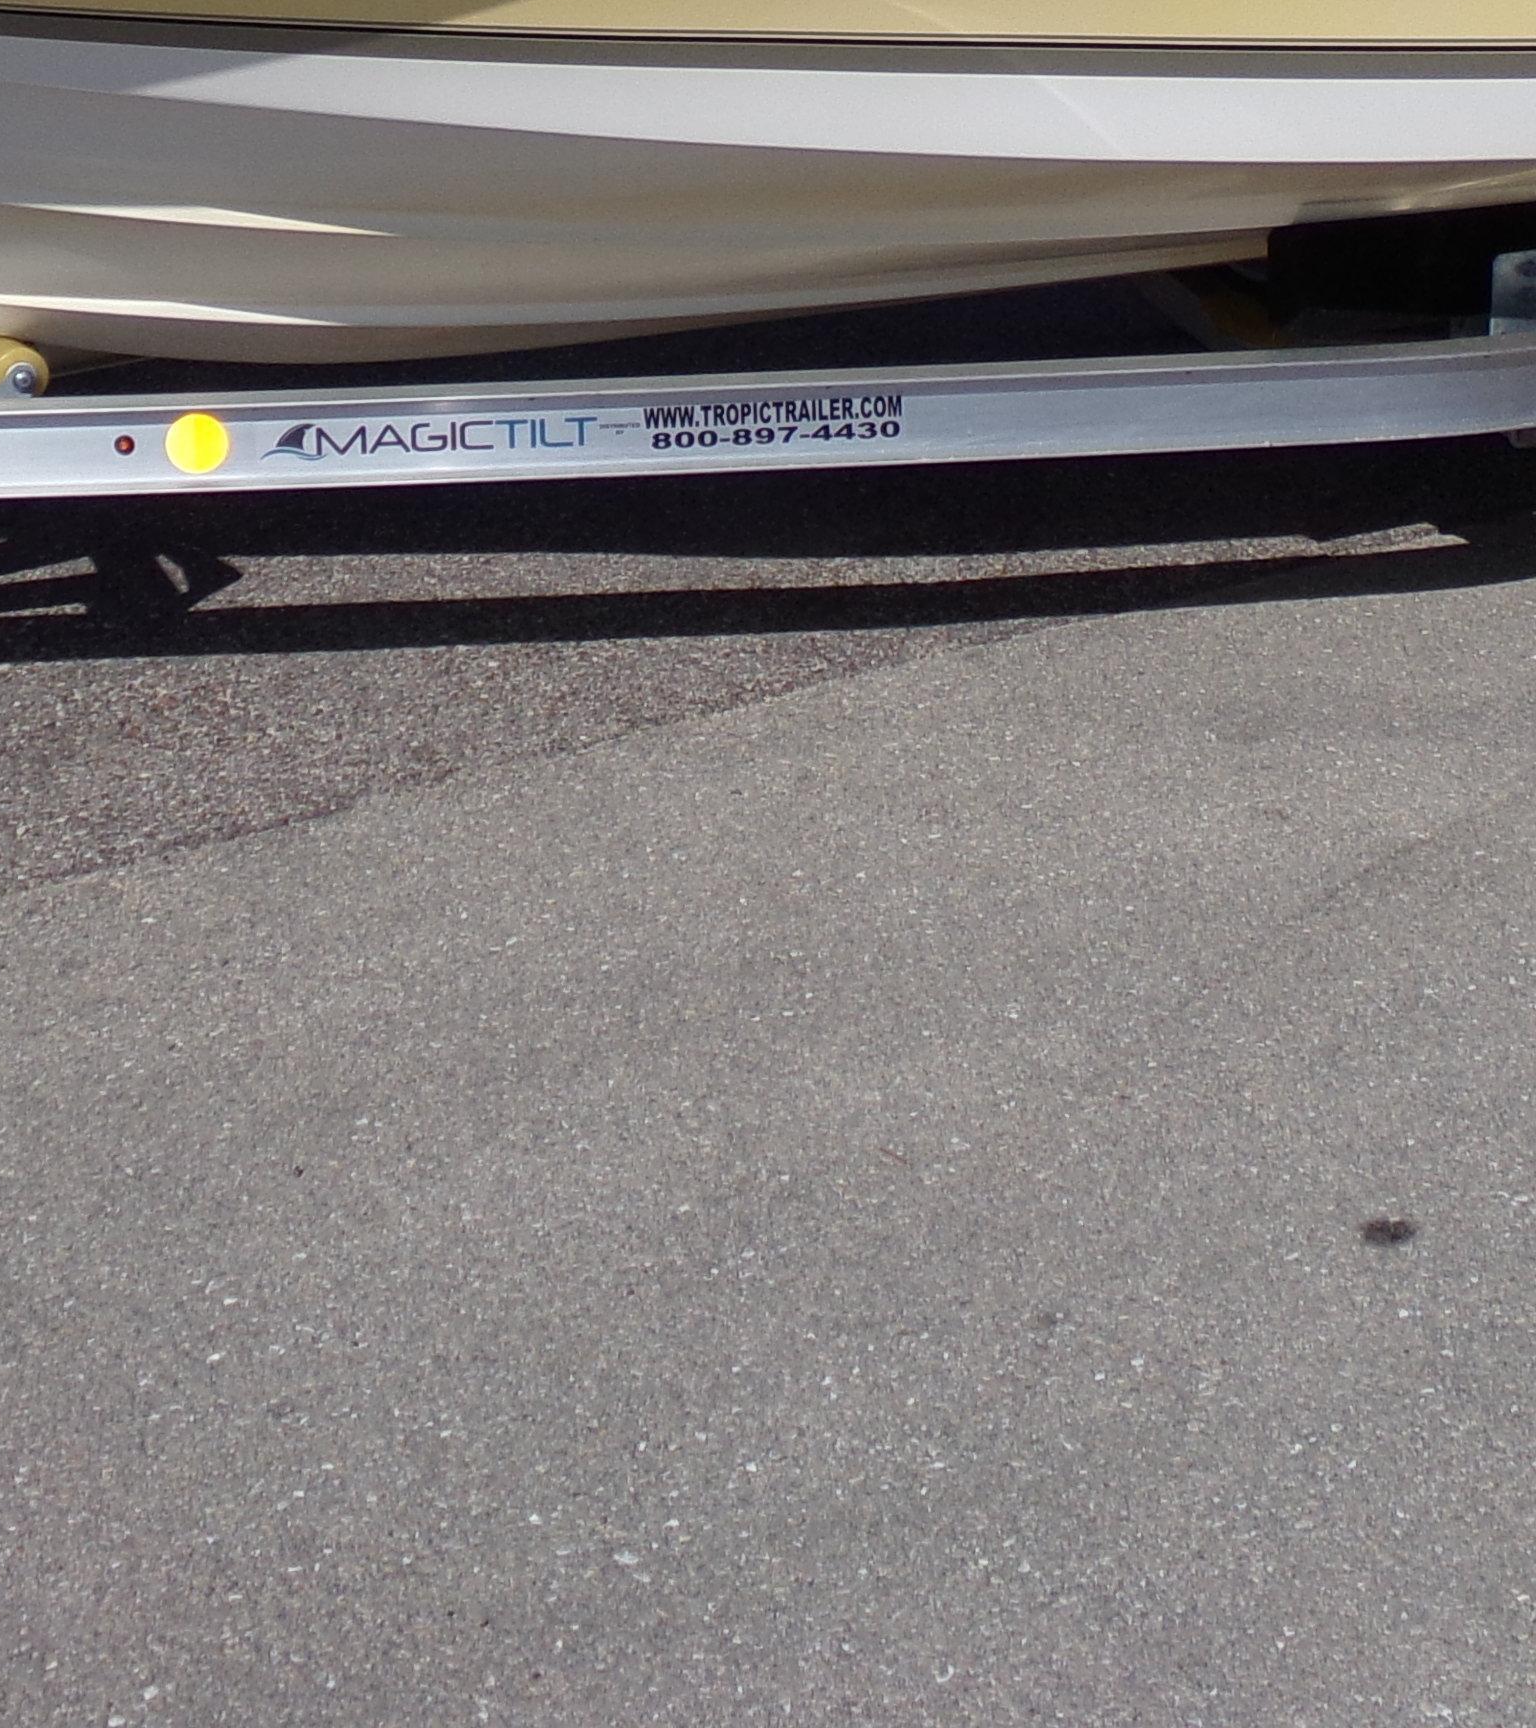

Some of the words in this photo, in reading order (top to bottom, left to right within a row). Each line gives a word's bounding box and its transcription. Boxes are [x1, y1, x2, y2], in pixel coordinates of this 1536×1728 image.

[643, 396, 903, 429] WWW.TROPICTRAILER.COM
[315, 416, 598, 457] MAGICTILT
[650, 420, 901, 450] 800-897-4430
